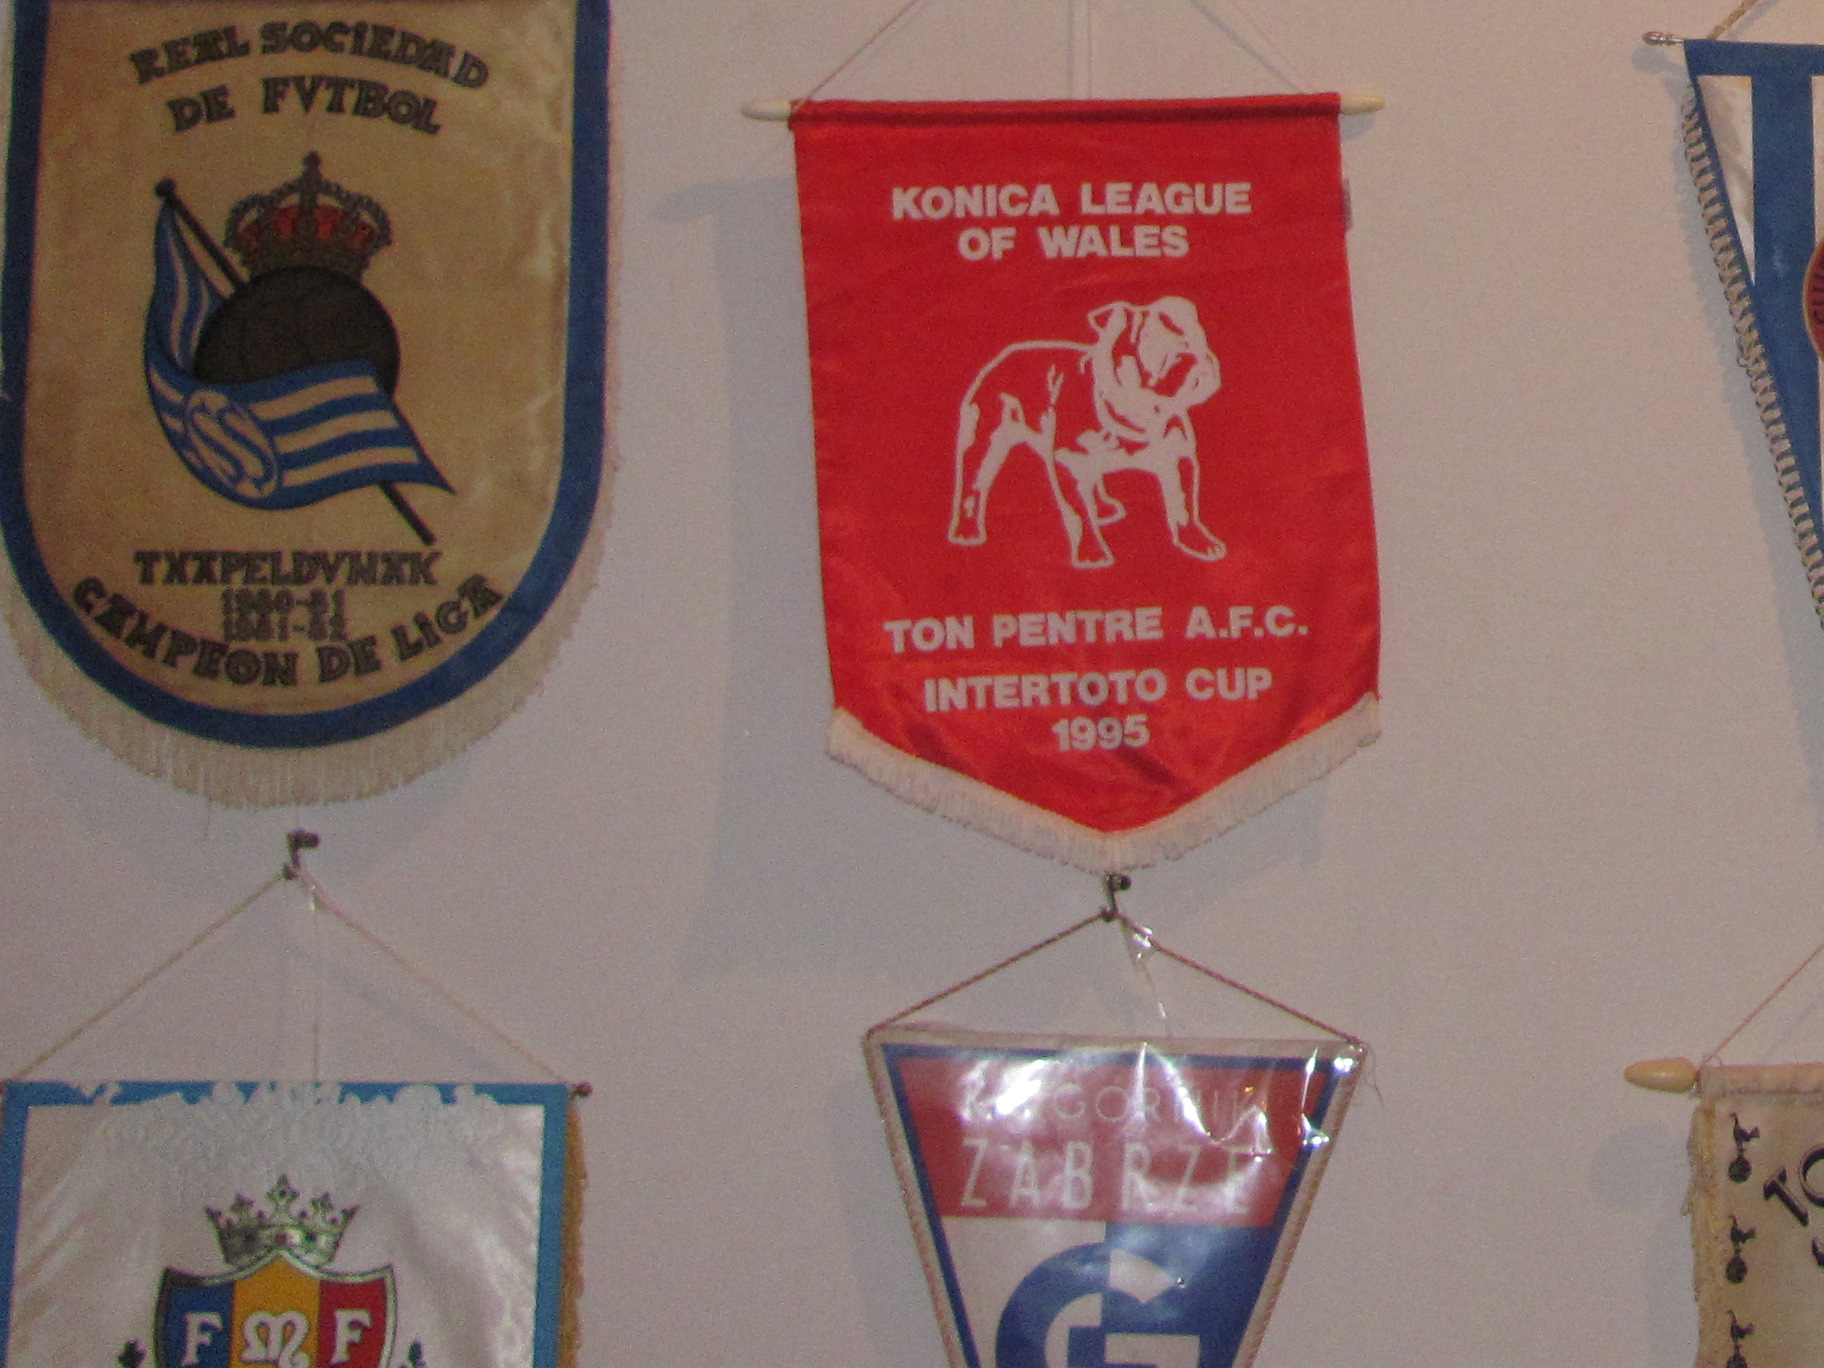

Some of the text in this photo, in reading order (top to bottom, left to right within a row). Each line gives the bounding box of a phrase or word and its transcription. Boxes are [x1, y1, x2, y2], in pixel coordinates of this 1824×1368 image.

[128, 17, 490, 90] REAL SOCIEDAD
[167, 75, 443, 135] DE FVTBOL
[891, 181, 1251, 220] KONICA LEAGUE
[957, 224, 1190, 261] OF WALES
[71, 572, 504, 687] CAMPEON DE LIGA
[882, 605, 1309, 653] TON PENTRE A.F.C.
[923, 667, 1274, 712] INTERTOTO CUP
[1050, 715, 1151, 751] 1995
[961, 1137, 1249, 1214] ZABRZE
[182, 1312, 223, 1367] F
[330, 1309, 373, 1365] F
